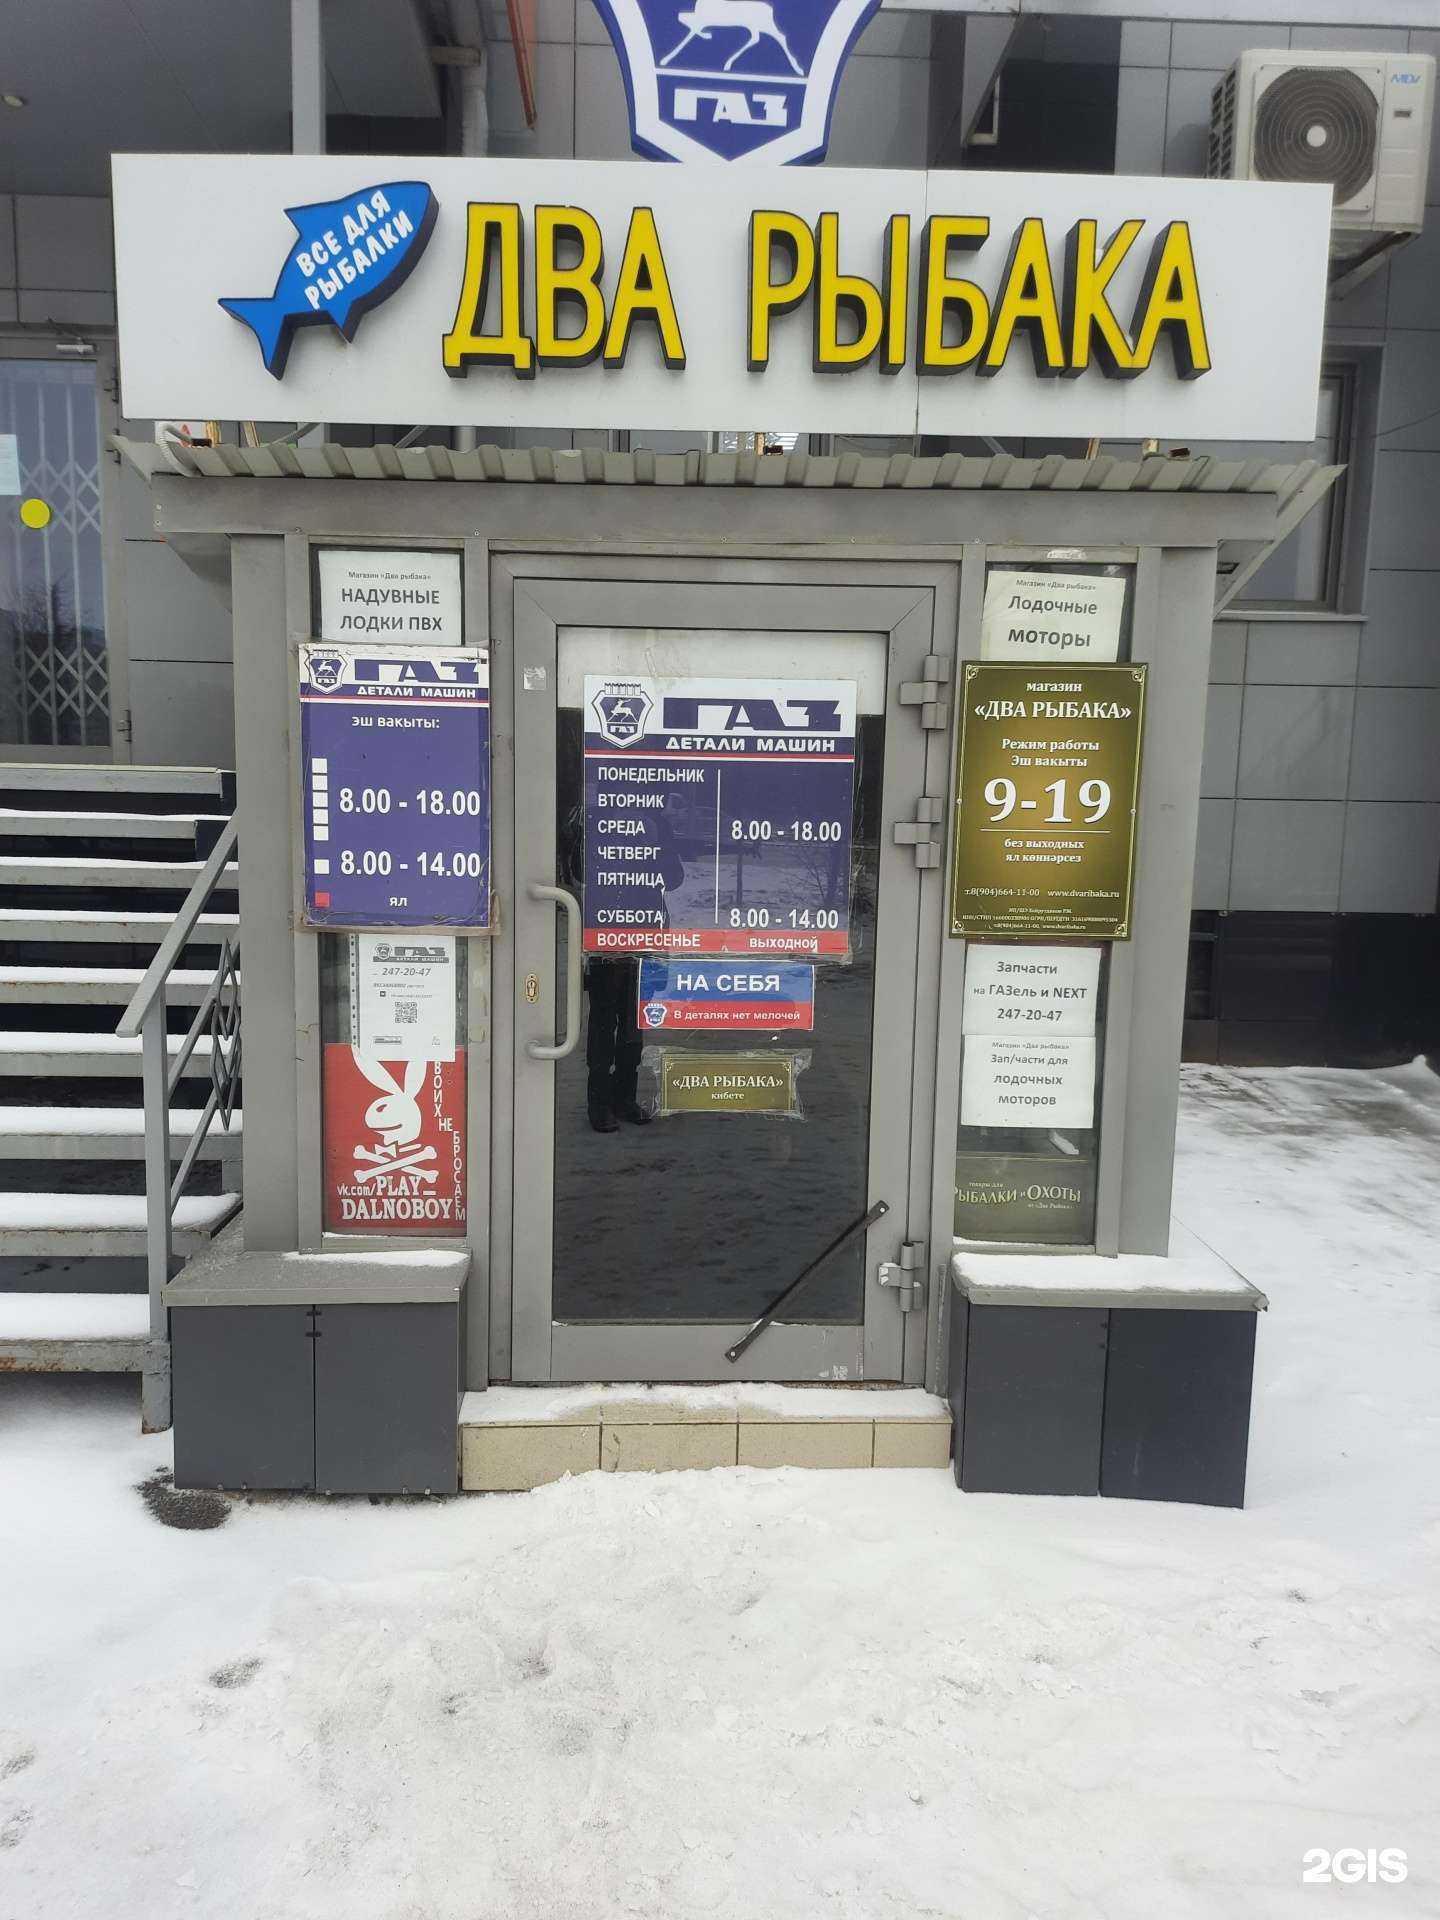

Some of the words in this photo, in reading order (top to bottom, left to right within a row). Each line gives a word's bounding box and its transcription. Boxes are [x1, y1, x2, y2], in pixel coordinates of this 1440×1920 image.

[673, 88, 788, 127] ГАЗ
[296, 230, 342, 277] ВСЕ
[342, 190, 391, 246] ДЛЯ
[304, 210, 414, 310] РЫБАЛКИ
[442, 202, 686, 380] ДВА
[747, 209, 1212, 379] РЫБАКА
[341, 588, 441, 606] НАДУВНЫЕ
[1008, 595, 1098, 614] Лодочные
[340, 615, 403, 632] ЛОДКИ
[409, 616, 443, 631] ПВХ
[1008, 628, 1091, 650] моторы
[354, 659, 480, 684] ГАЗ
[357, 686, 413, 697] ДЕТАЛИ
[421, 687, 476, 698] МАШИН
[1026, 682, 1082, 692] магазин
[663, 697, 842, 731] ГАЗ
[974, 701, 1027, 720] «ДВА
[1032, 701, 1132, 719] РЫБАКА»
[352, 716, 373, 727] эш
[377, 717, 440, 729] вакыты:
[665, 737, 746, 751] ДЕТАЛИ
[756, 738, 835, 752] МАШИН
[1002, 738, 1046, 750] Режим
[1050, 740, 1100, 752] работы
[1011, 756, 1031, 766] Эш
[1035, 757, 1087, 767] вакыты
[598, 766, 705, 784] ПОНЕДЕЛЬНИК
[339, 788, 391, 814] 8.00
[416, 790, 481, 816] 18.00
[598, 793, 665, 808] ВТОРНИК
[984, 778, 1111, 823] 9-19
[597, 820, 645, 836] СРЕДА
[731, 820, 771, 840] 8.00
[791, 821, 842, 841] 18.00
[1004, 838, 1023, 848] без
[1026, 840, 1085, 850] выходных
[597, 846, 661, 860] ЧЕТВЕРГ
[340, 850, 392, 875] 8.00
[416, 852, 481, 877] 14.00
[597, 872, 665, 888] ПЯТНИЦА
[389, 897, 408, 907] ял
[597, 909, 664, 924] СУББОТА
[730, 908, 769, 928] 8.00
[788, 909, 839, 929] 14.00
[597, 933, 701, 947] ВОСКРЕСЕНЬЕ
[382, 967, 431, 976] 247-20-47
[996, 961, 1058, 974] Запчасти
[676, 974, 710, 991] НА
[716, 974, 780, 992] СЕБЯ
[974, 987, 985, 995] на
[989, 984, 1037, 997] ГАЗель
[1053, 987, 1088, 999] NEXT
[674, 1010, 682, 1019] В
[685, 1011, 729, 1020] деталях
[732, 1011, 751, 1019] нет
[753, 1010, 801, 1020] мелочей
[997, 1008, 1063, 1021] 247-20-47
[991, 1054, 1045, 1064] Зап/части
[1048, 1057, 1068, 1065] для
[672, 1075, 710, 1089] «ДВА
[713, 1075, 784, 1088] РЫБАКА»
[993, 1074, 1063, 1086] лодочных
[711, 1091, 745, 1100] кибете
[998, 1095, 1057, 1107] моторов
[433, 1061, 443, 1118] ВОИХ
[438, 1118, 453, 1131] НЕ
[452, 1131, 467, 1221] БРОСАЕМ
[341, 1198, 454, 1220] DALNOBOY
